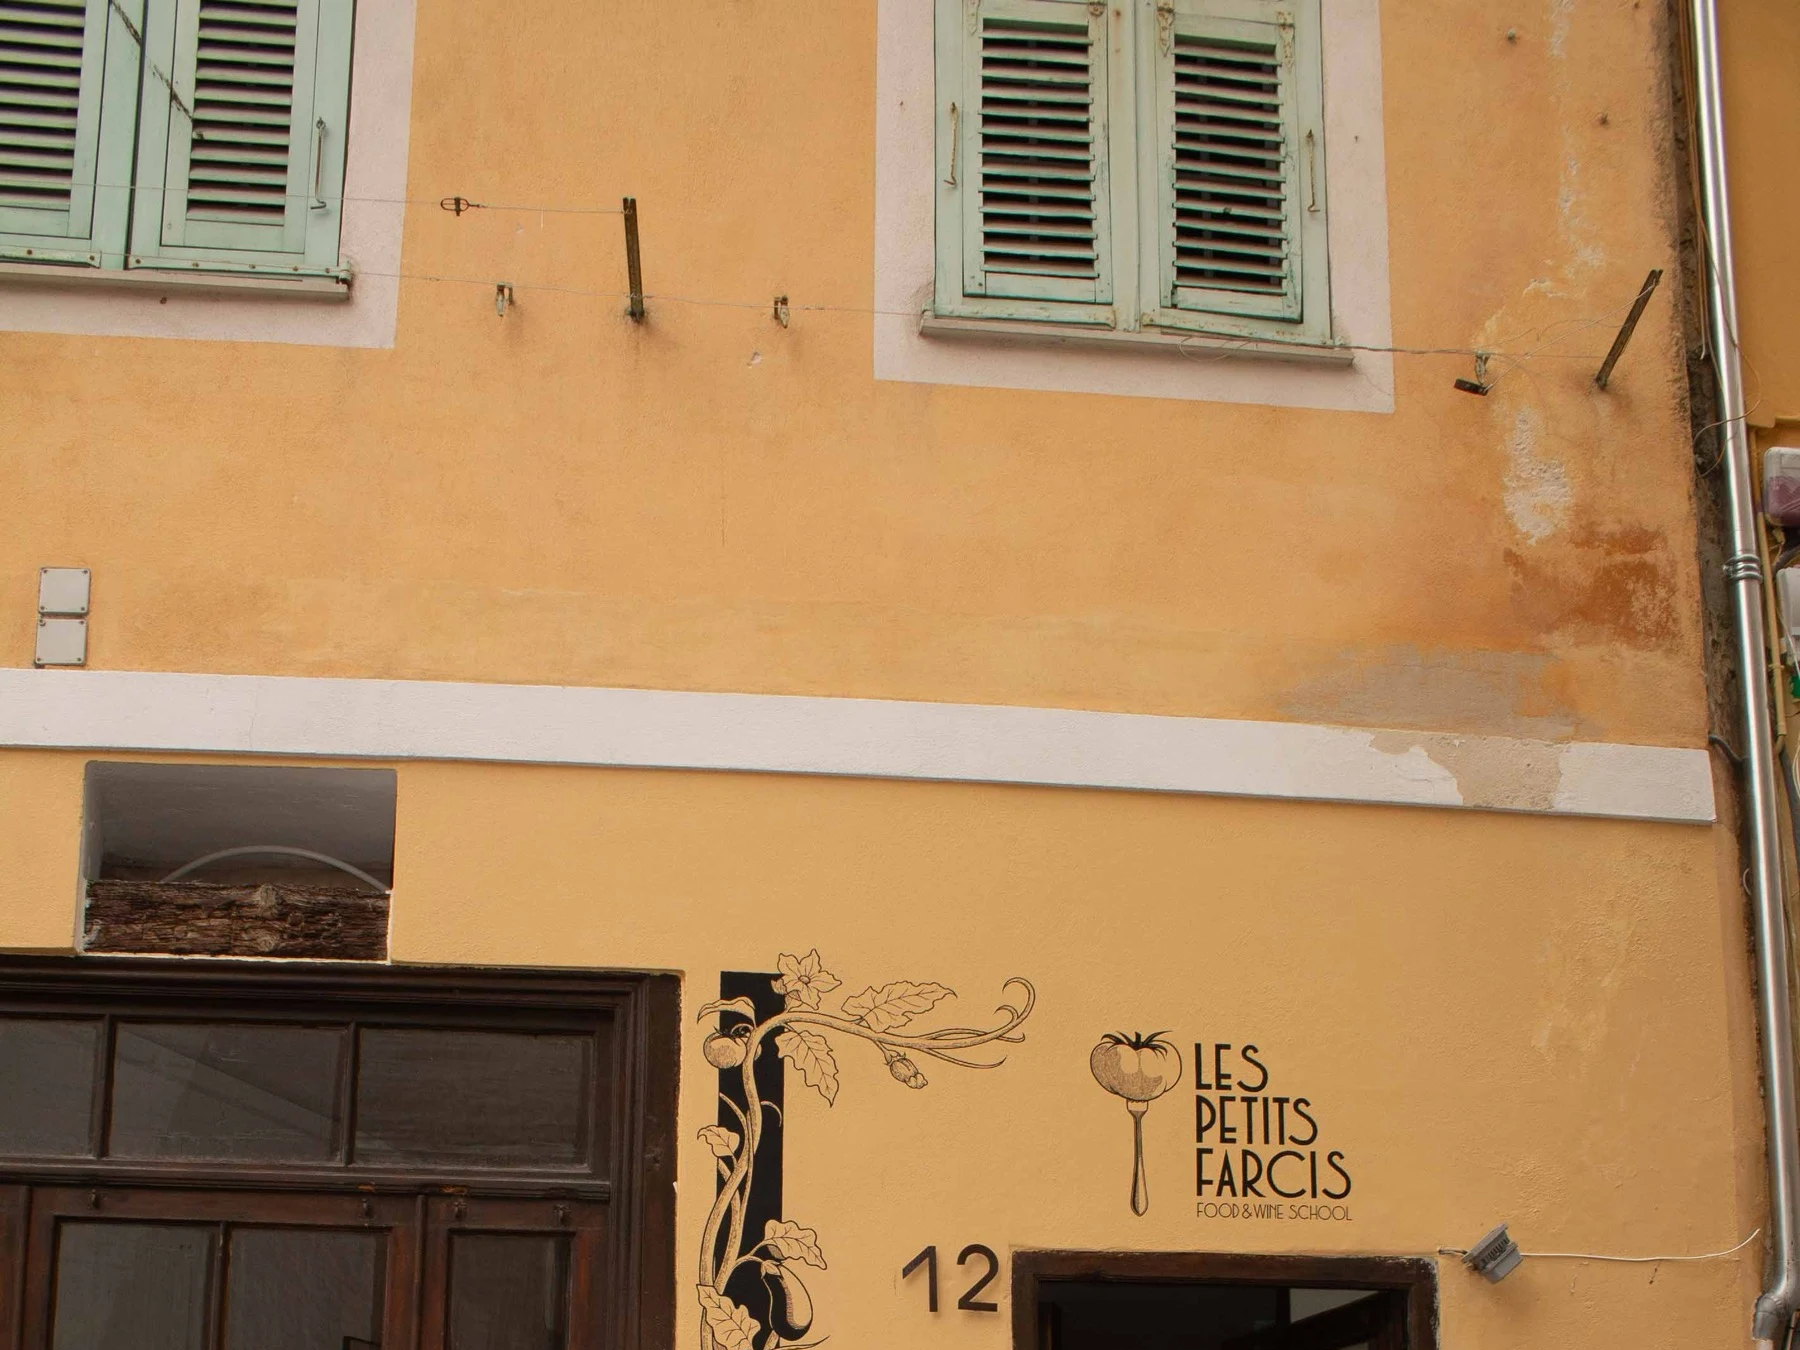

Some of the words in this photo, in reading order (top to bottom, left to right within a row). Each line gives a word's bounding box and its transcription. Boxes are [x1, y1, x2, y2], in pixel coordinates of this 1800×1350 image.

[1194, 1042, 1269, 1093] LES
[1195, 1094, 1318, 1146] PETITS
[1196, 1147, 1352, 1200] FARCIS
[1288, 1204, 1353, 1221] SCHOOL
[902, 1243, 999, 1313] 12
